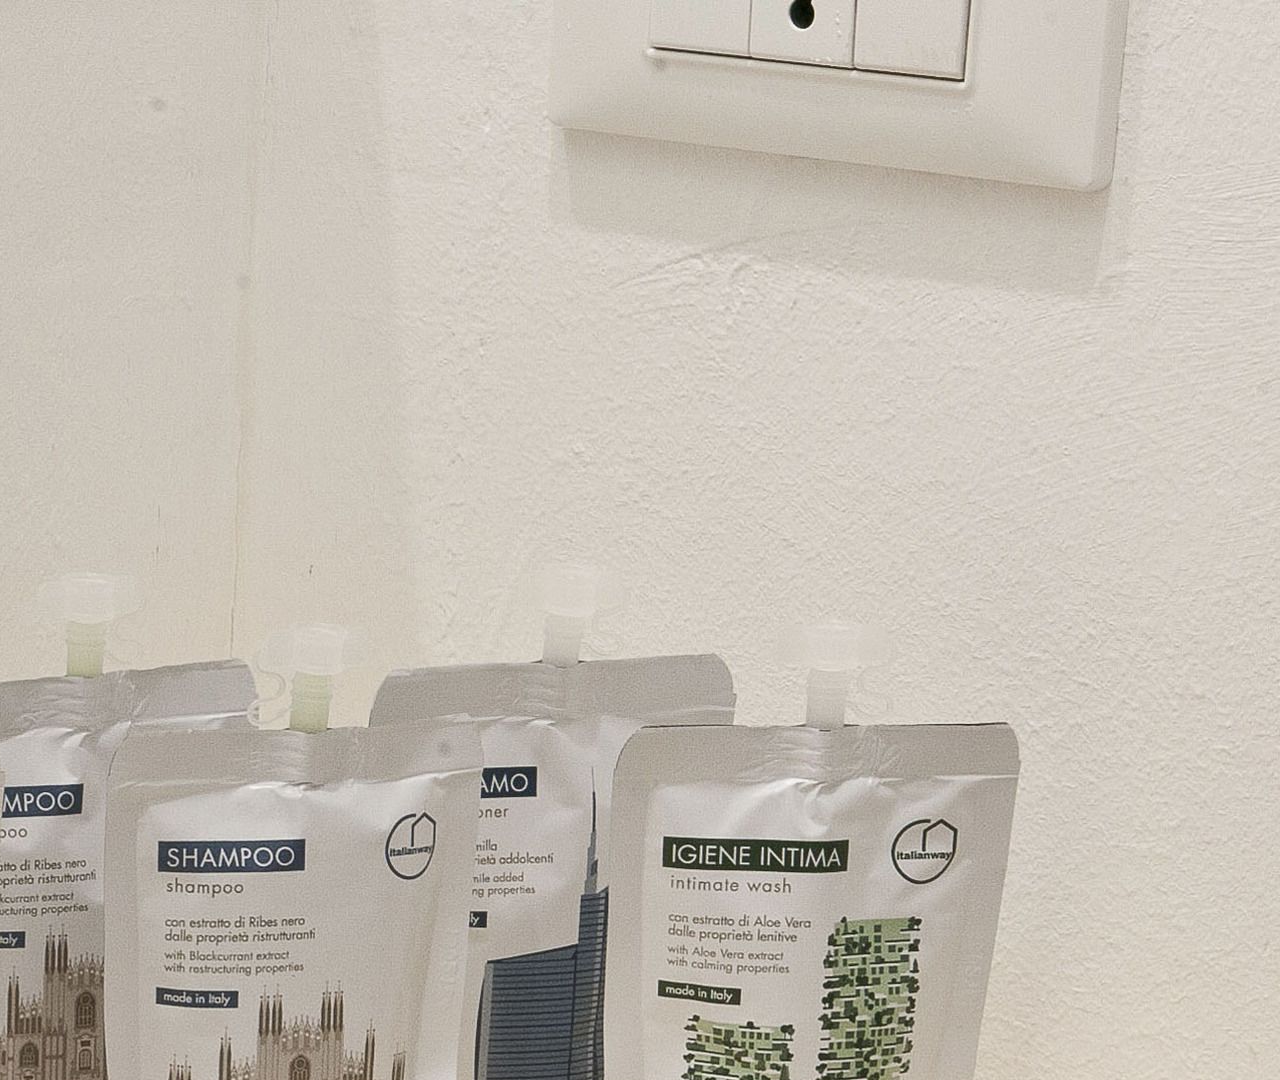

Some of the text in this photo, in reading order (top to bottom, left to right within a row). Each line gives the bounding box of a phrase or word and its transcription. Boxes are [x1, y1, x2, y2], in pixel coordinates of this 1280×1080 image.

[167, 847, 295, 868] SHAMPOO
[499, 852, 554, 864] addolcenti
[672, 844, 841, 867] IGIENE INTIMA
[20, 859, 30, 871] di
[34, 858, 62, 871] Ribes
[65, 859, 86, 869] nero
[493, 874, 523, 883] added
[670, 875, 792, 893] intimate wash
[166, 878, 244, 898] shampoo
[488, 887, 535, 897] properties
[42, 892, 73, 901] extract
[41, 904, 88, 915] properties
[165, 916, 305, 928] con estratto di Ribes nero
[669, 913, 811, 928] con estratto di Aloe Vera
[165, 928, 315, 945] dalle proprietà ristrutturanti
[668, 925, 798, 943] dalle proprietà lenitive
[164, 950, 289, 961] with Blackcurrant extract
[667, 944, 783, 961] with Aloe Vera extract
[164, 962, 304, 976] with restructuring properties
[667, 957, 790, 975] with calming properties
[163, 993, 231, 1006] made in Italy
[665, 986, 733, 1002] made in Italy
